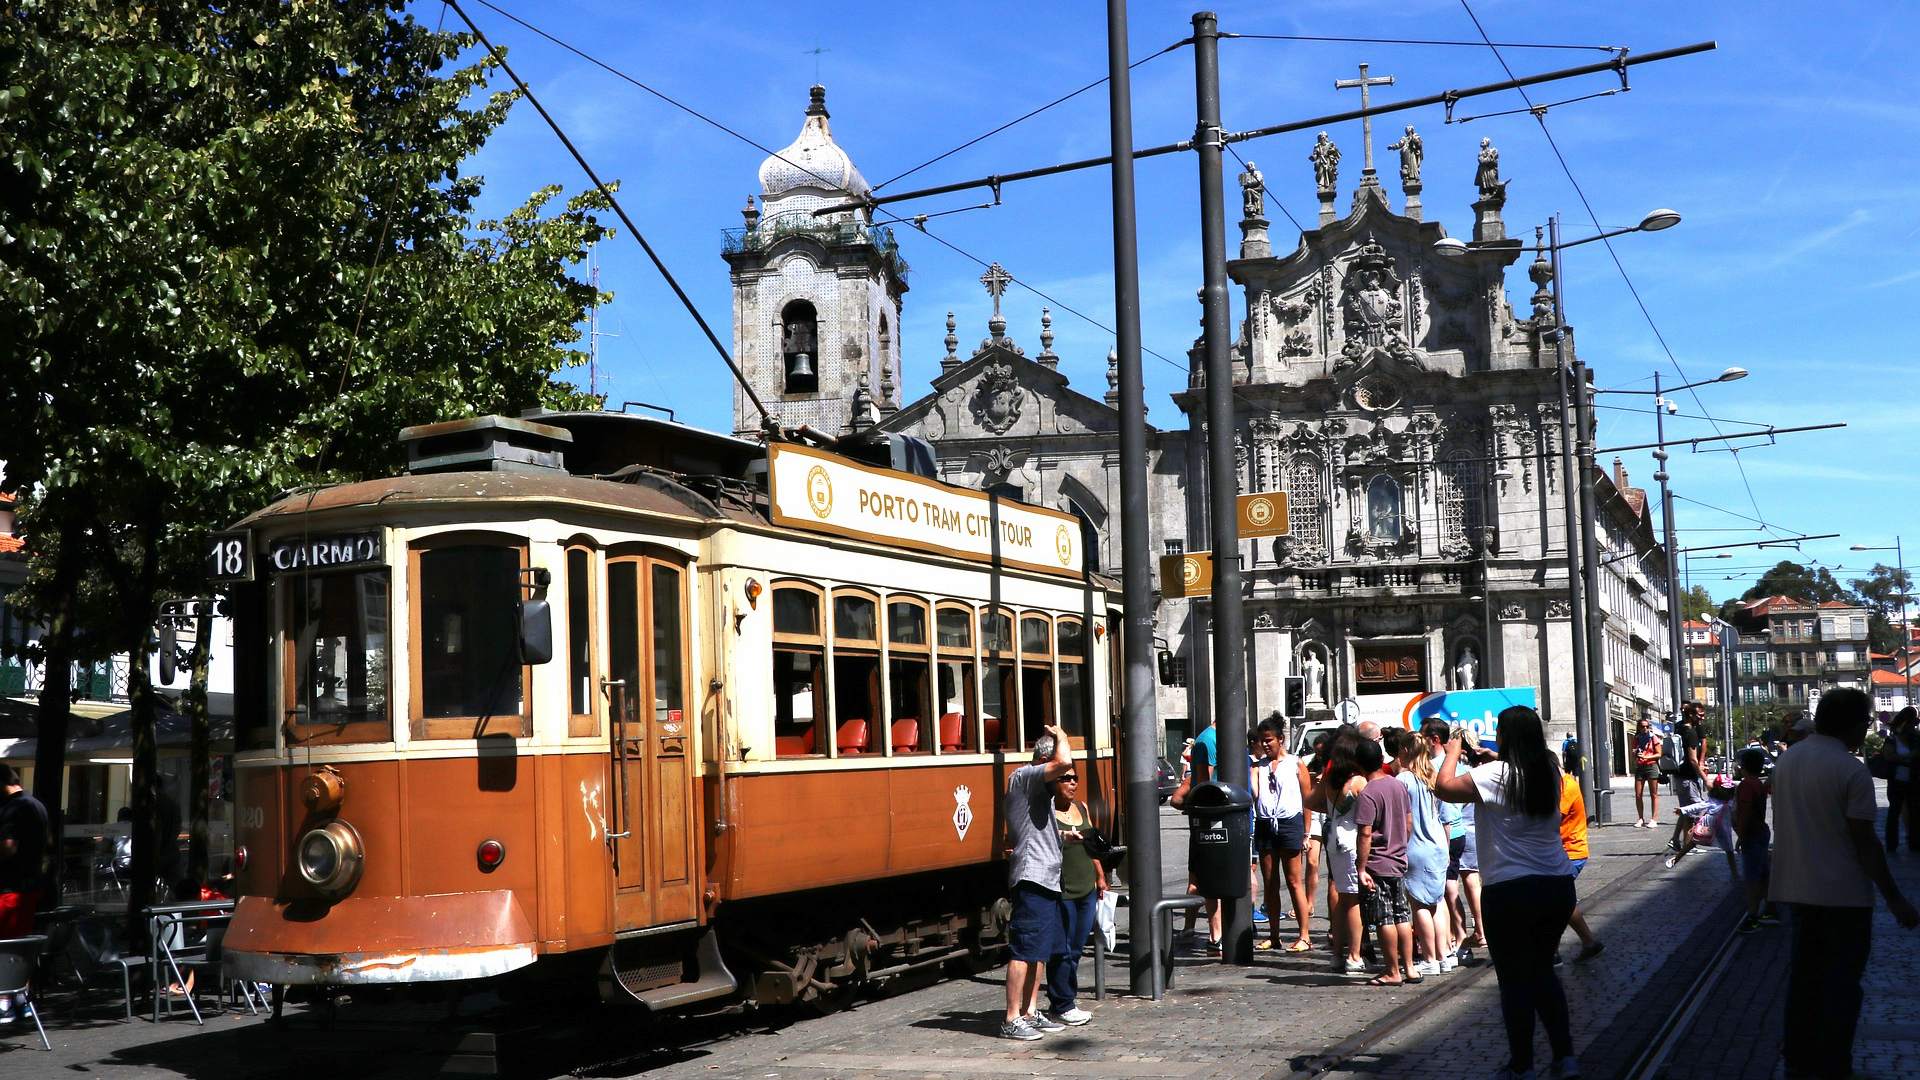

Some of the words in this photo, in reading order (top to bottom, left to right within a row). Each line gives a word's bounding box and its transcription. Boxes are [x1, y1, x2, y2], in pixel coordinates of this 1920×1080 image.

[859, 488, 919, 523] PORTO
[922, 502, 962, 533] TRAM
[966, 512, 998, 540] CITY
[1000, 520, 1033, 548] TOUR
[208, 540, 243, 575] 18
[274, 536, 374, 570] CARMO
[1199, 831, 1225, 841] Porto.
